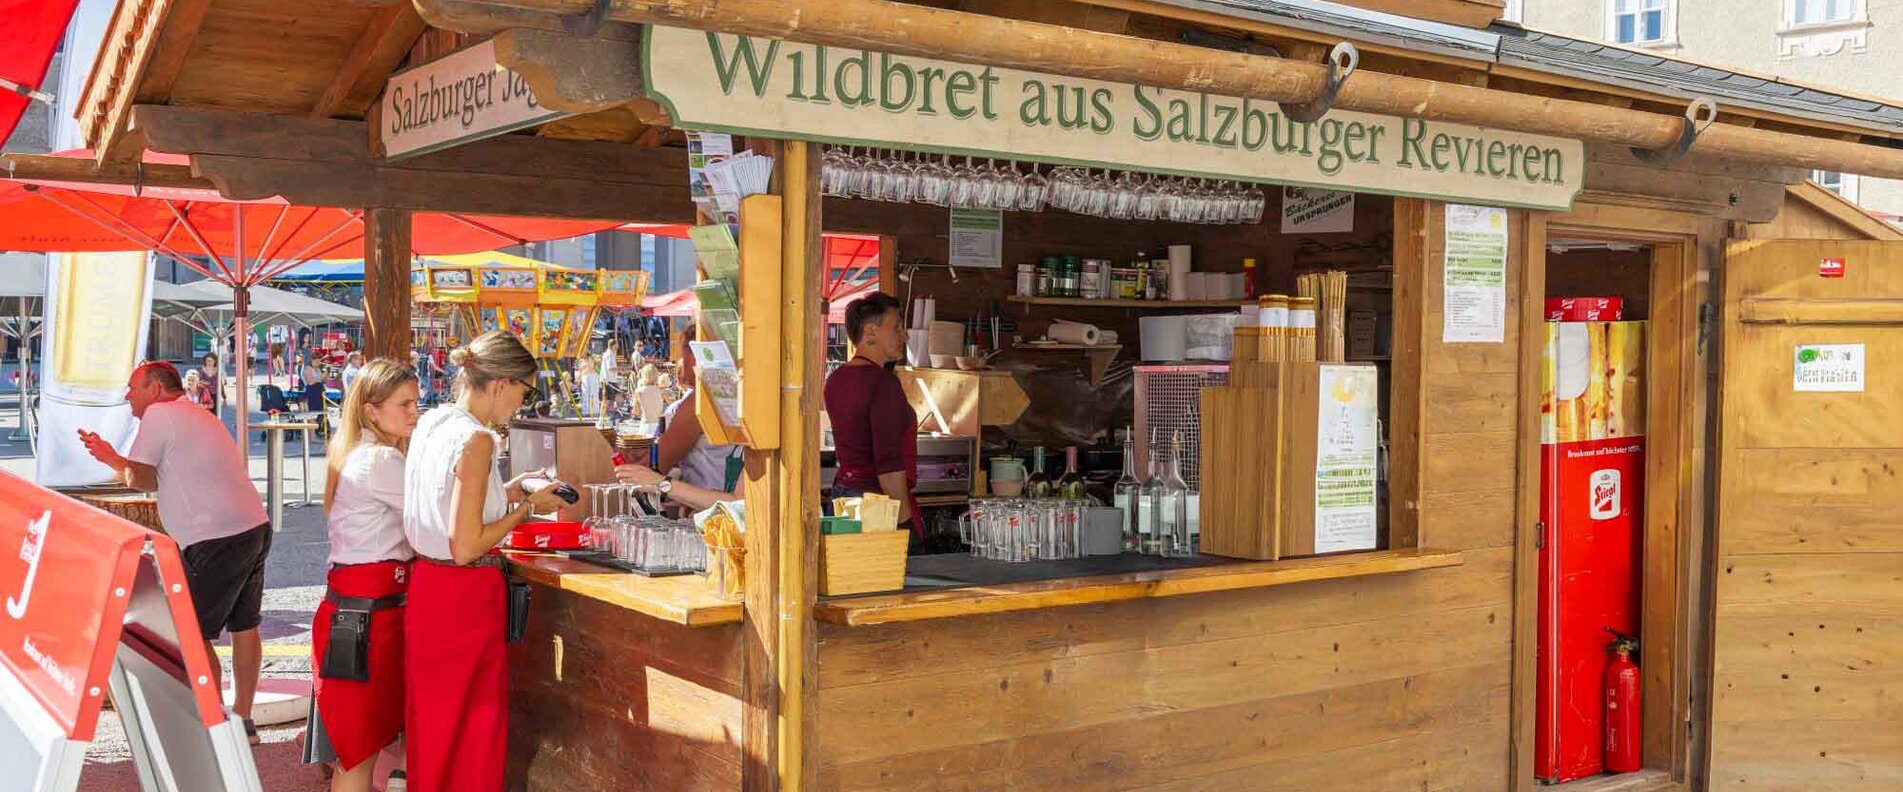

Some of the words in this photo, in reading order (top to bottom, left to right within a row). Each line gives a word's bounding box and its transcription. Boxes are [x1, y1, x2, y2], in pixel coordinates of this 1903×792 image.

[391, 69, 497, 134] Salzburger
[705, 31, 1000, 120] Wildbret
[1019, 80, 1115, 134] aus
[1133, 84, 1385, 175] Salzburger
[1396, 118, 1565, 186] Revieren
[1595, 483, 1616, 507] Stiegl
